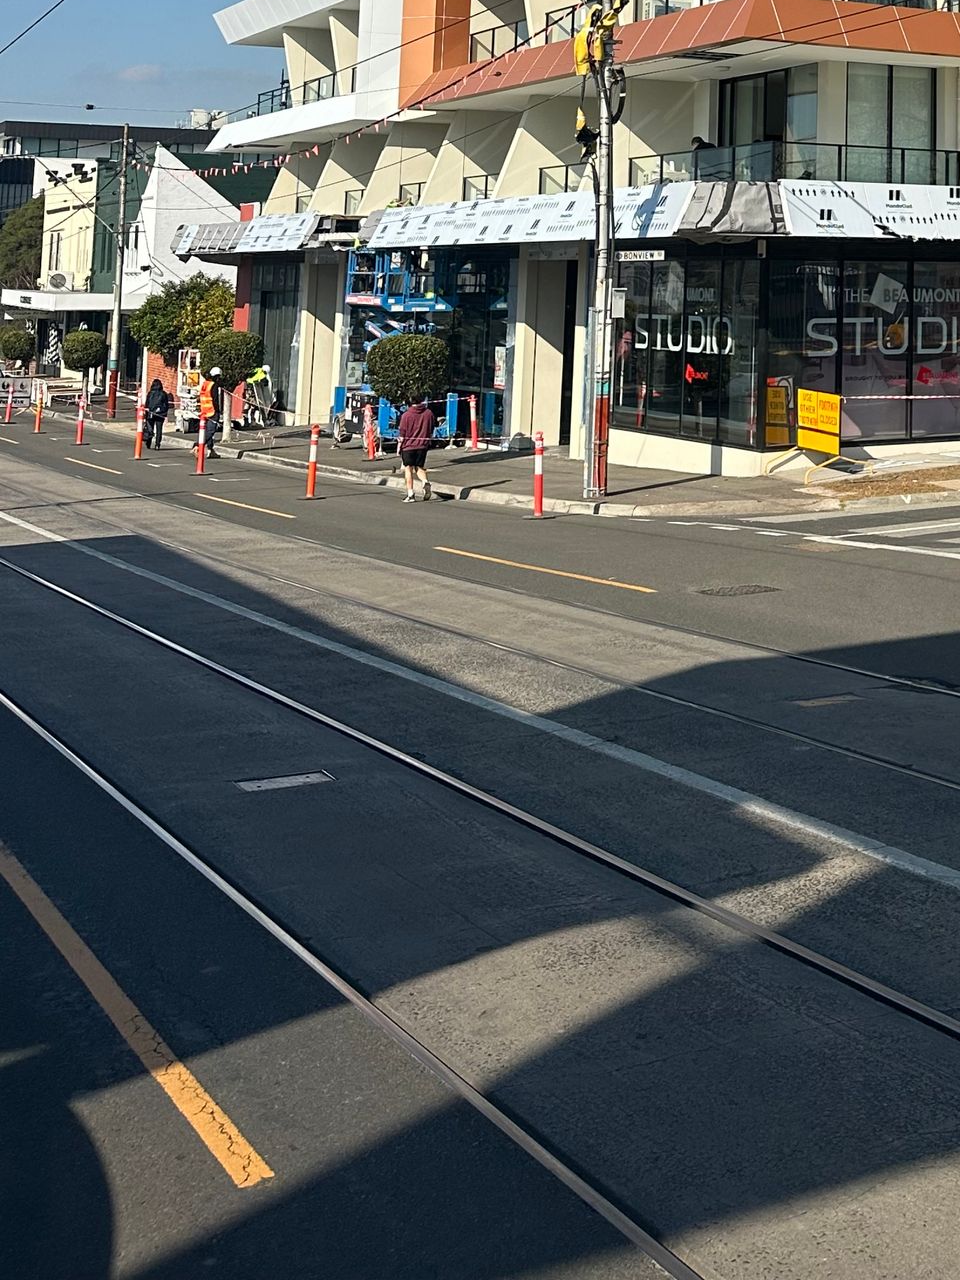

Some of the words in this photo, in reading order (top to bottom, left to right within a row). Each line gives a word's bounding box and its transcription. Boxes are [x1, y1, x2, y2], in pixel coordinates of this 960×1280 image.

[623, 251, 655, 260] BONVIEW
[844, 288, 870, 303] THE
[635, 313, 735, 356] STUDIO
